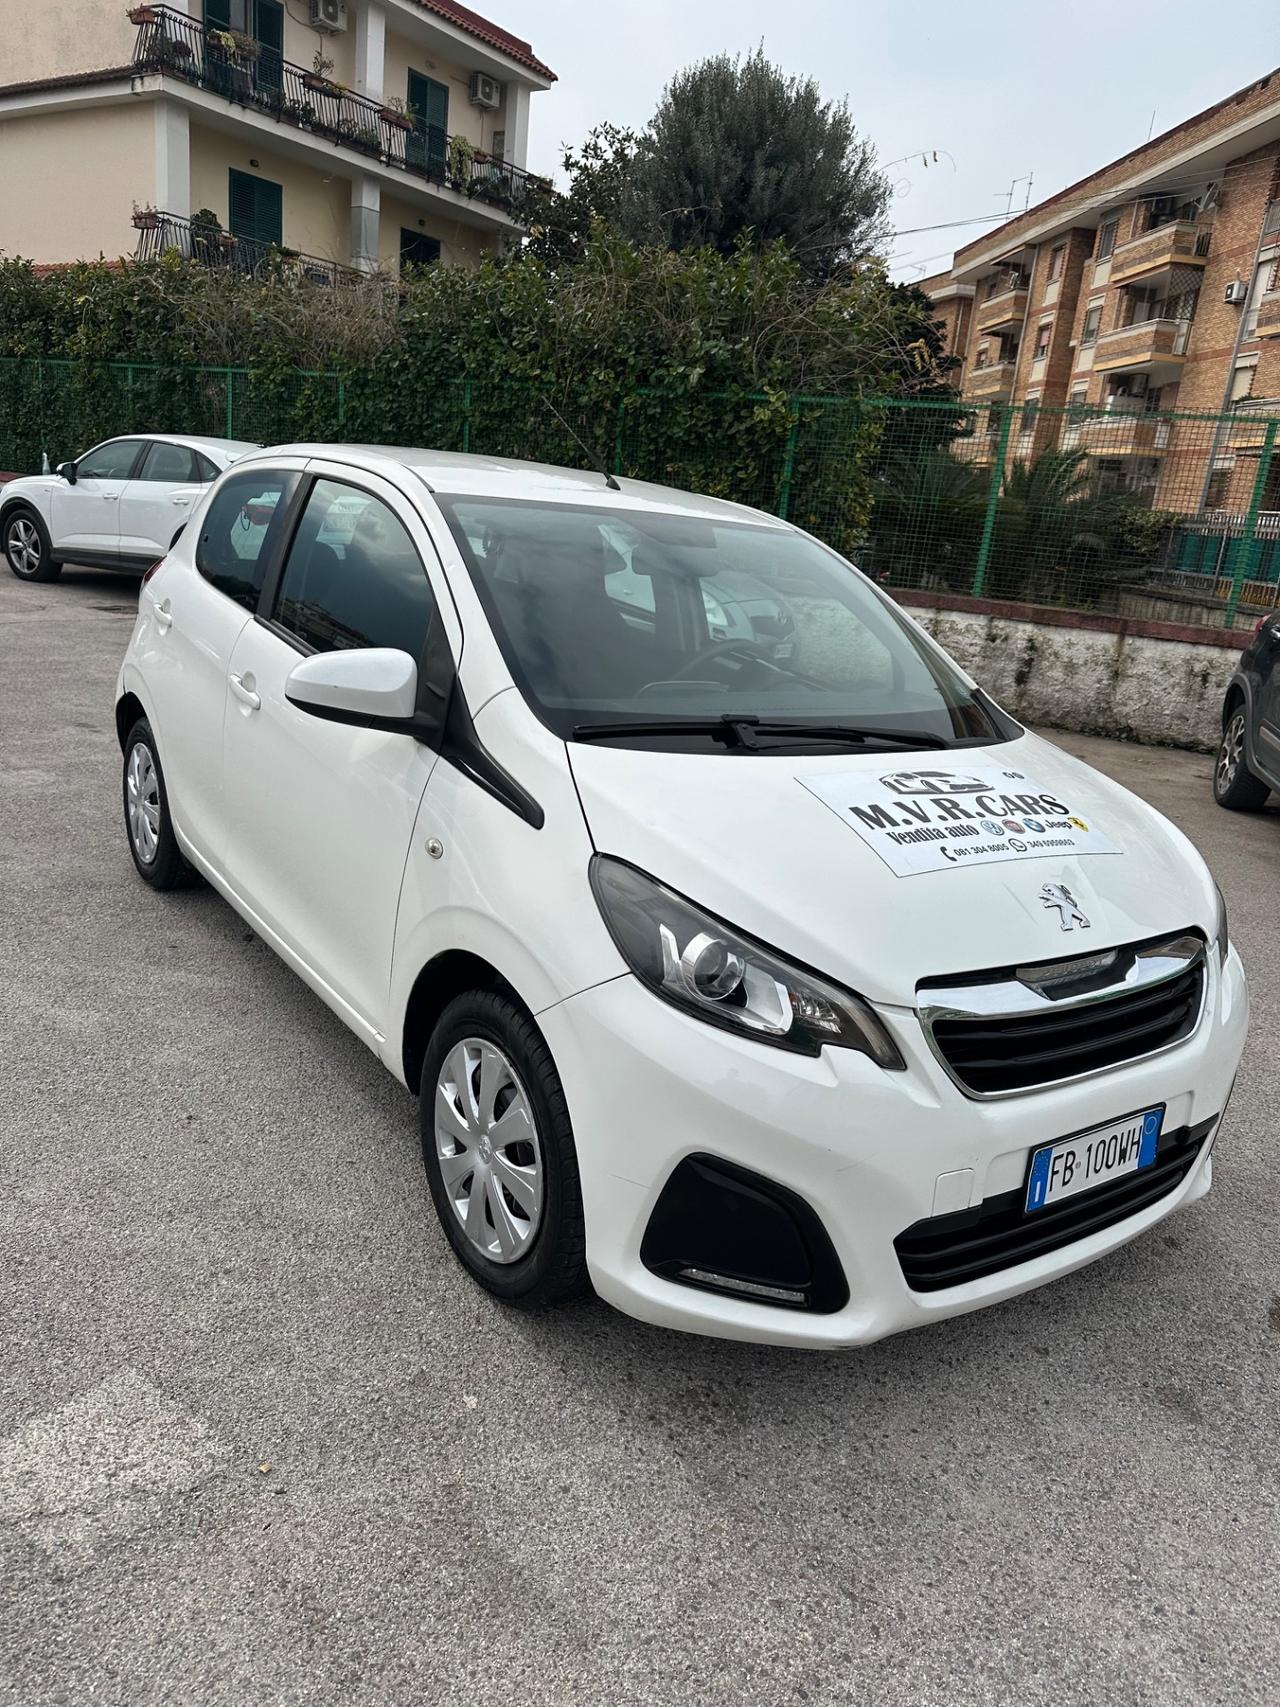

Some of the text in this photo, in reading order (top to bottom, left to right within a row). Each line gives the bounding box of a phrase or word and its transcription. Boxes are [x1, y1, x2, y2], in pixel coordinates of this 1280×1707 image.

[848, 794, 1069, 830] M.V.R.CARS
[885, 823, 980, 845] Vendita auto
